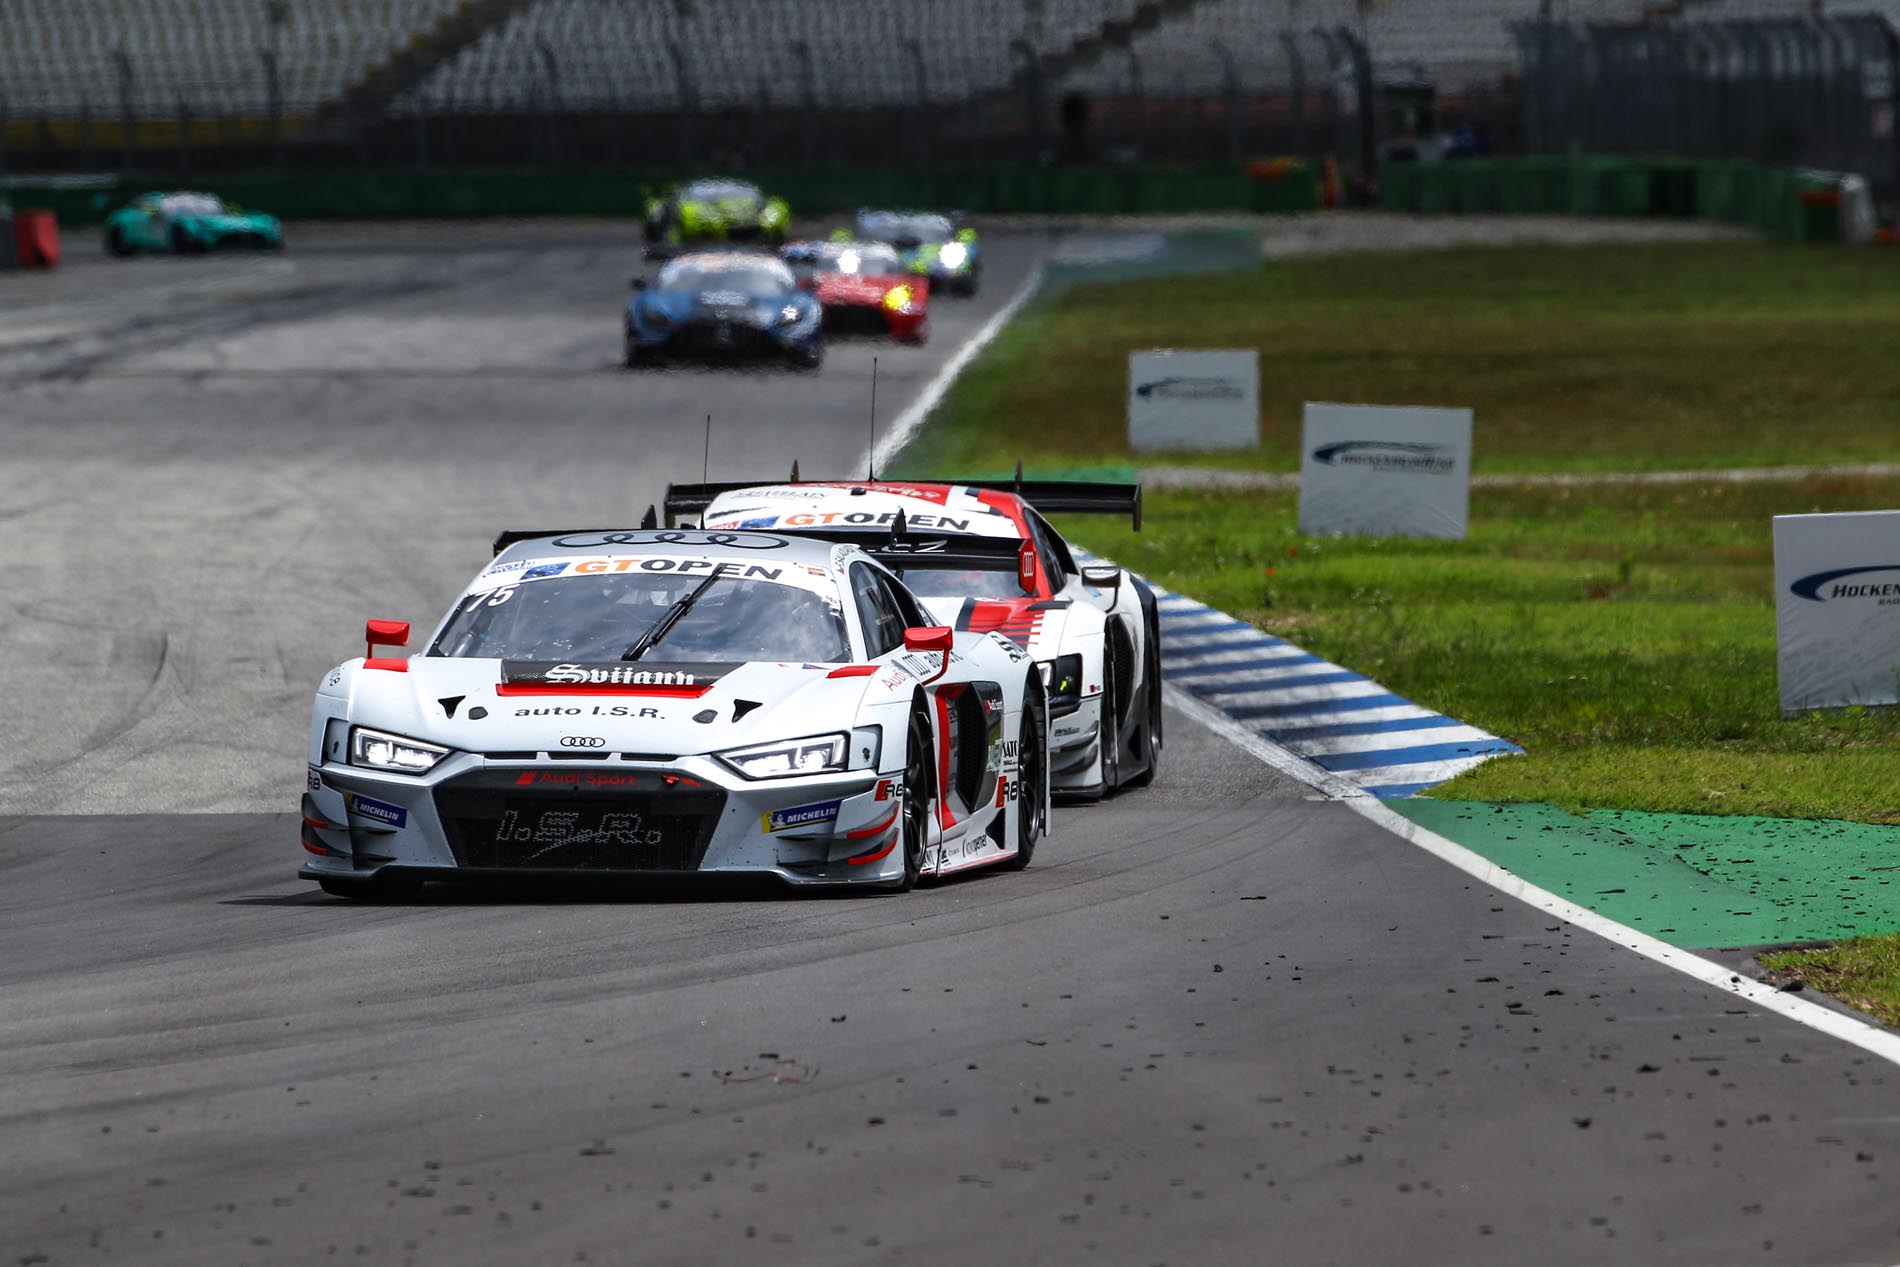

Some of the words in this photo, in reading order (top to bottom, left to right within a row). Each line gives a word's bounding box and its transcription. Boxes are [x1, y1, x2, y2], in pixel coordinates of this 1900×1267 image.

[466, 583, 521, 616] 75
[514, 705, 582, 718] auto
[591, 705, 666, 720] I.S.R.
[538, 771, 580, 784] Audi
[588, 772, 637, 787] Sport
[359, 803, 400, 821] MICHELIN
[786, 806, 837, 824] MICHELIN
